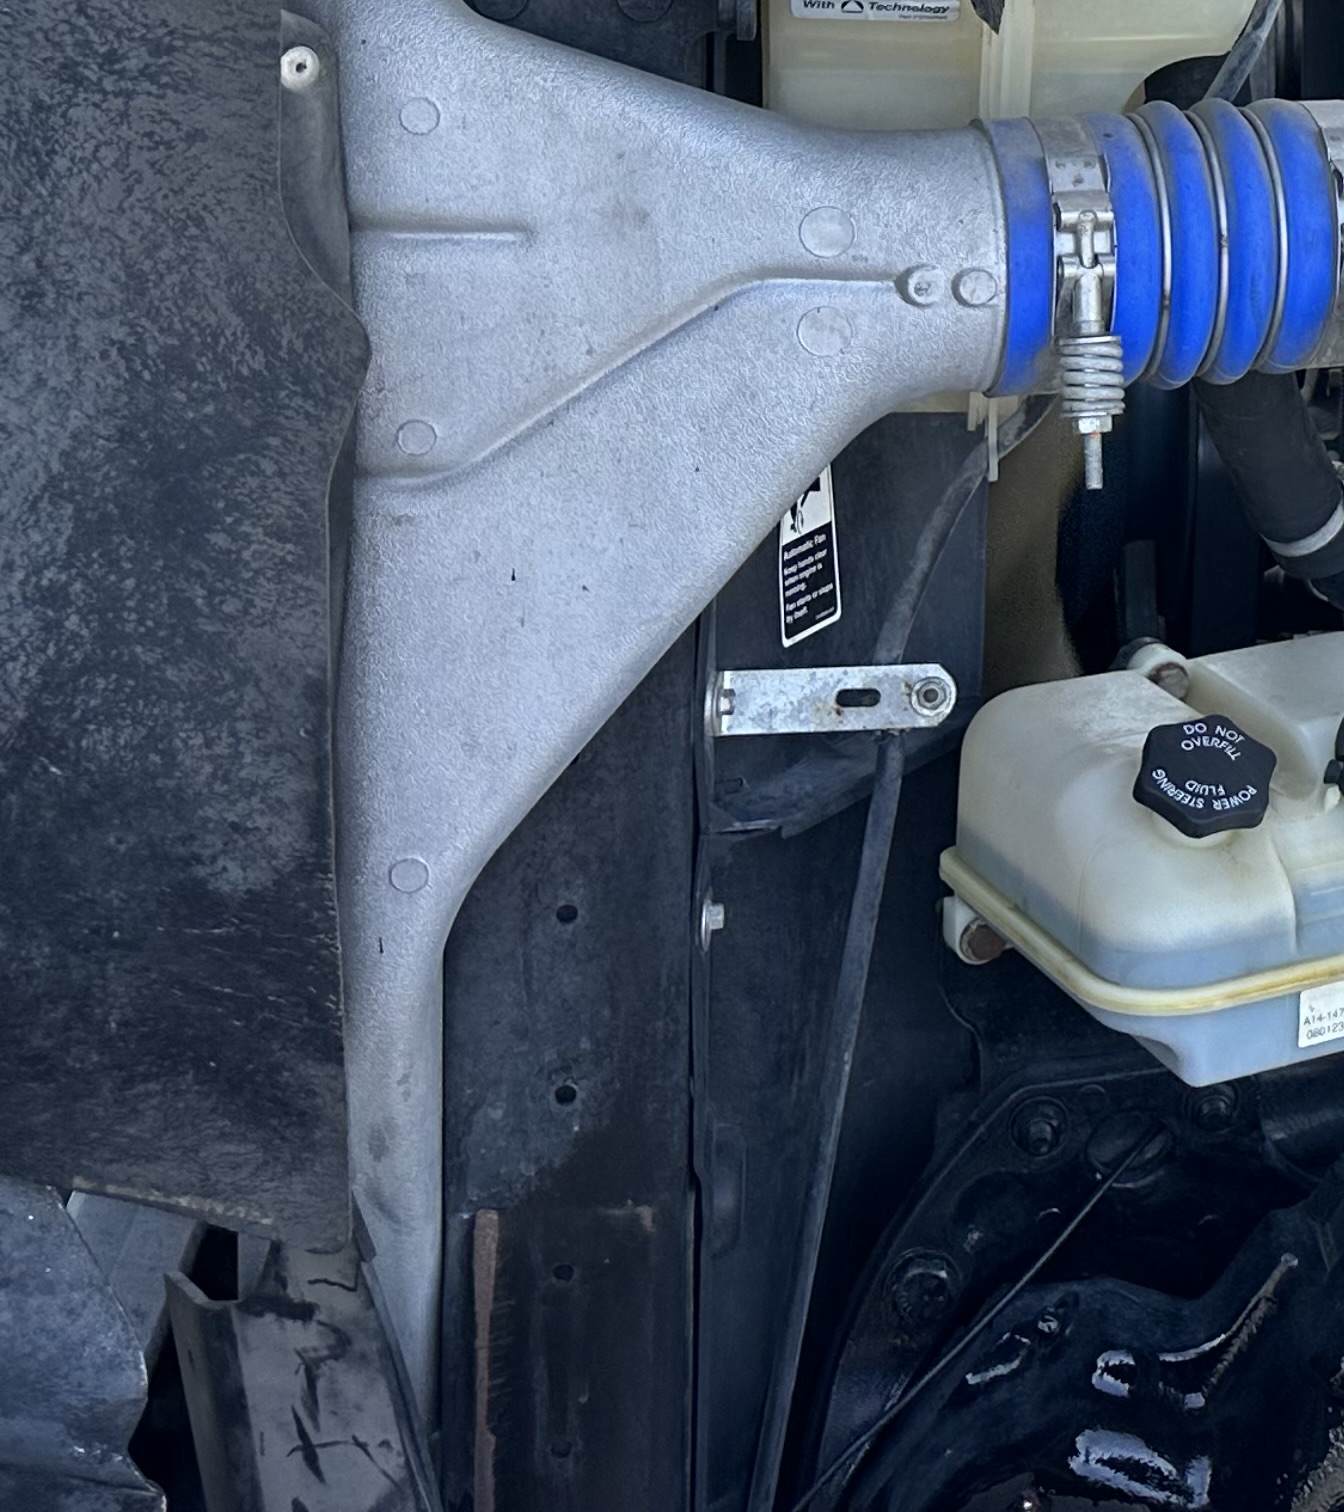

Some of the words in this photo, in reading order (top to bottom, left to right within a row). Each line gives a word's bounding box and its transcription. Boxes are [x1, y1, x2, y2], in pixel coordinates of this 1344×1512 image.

[803, 0, 836, 10] With
[868, 1, 951, 14] Technology
[1182, 722, 1208, 736] DO
[1214, 724, 1246, 744] NOT
[1180, 735, 1242, 761] OVERFILL
[1151, 768, 1206, 810] STEERING
[1184, 779, 1227, 797] FLUID
[1211, 784, 1258, 811] POWER
